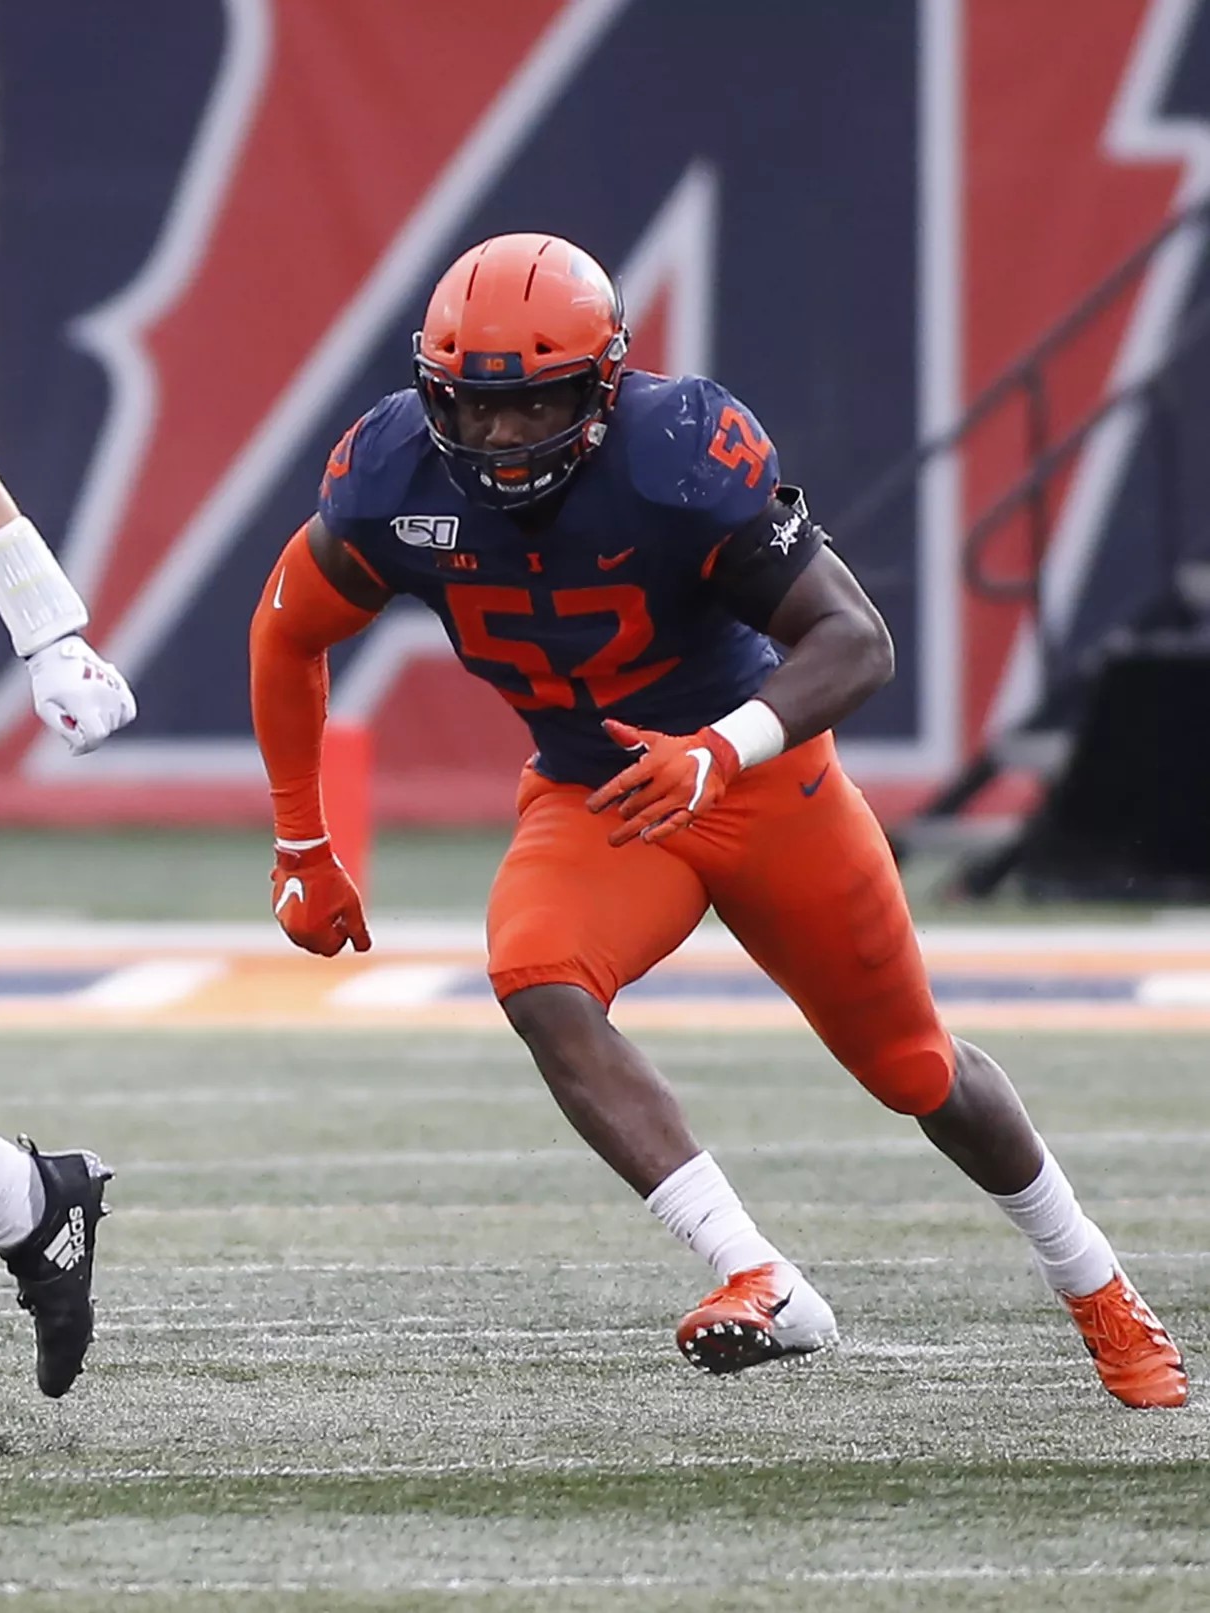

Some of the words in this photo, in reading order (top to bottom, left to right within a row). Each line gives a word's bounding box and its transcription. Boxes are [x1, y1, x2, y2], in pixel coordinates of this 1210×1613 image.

[708, 406, 770, 488] 52
[391, 516, 459, 549] 150
[445, 583, 682, 710] 52
[68, 1205, 86, 1264] didas
